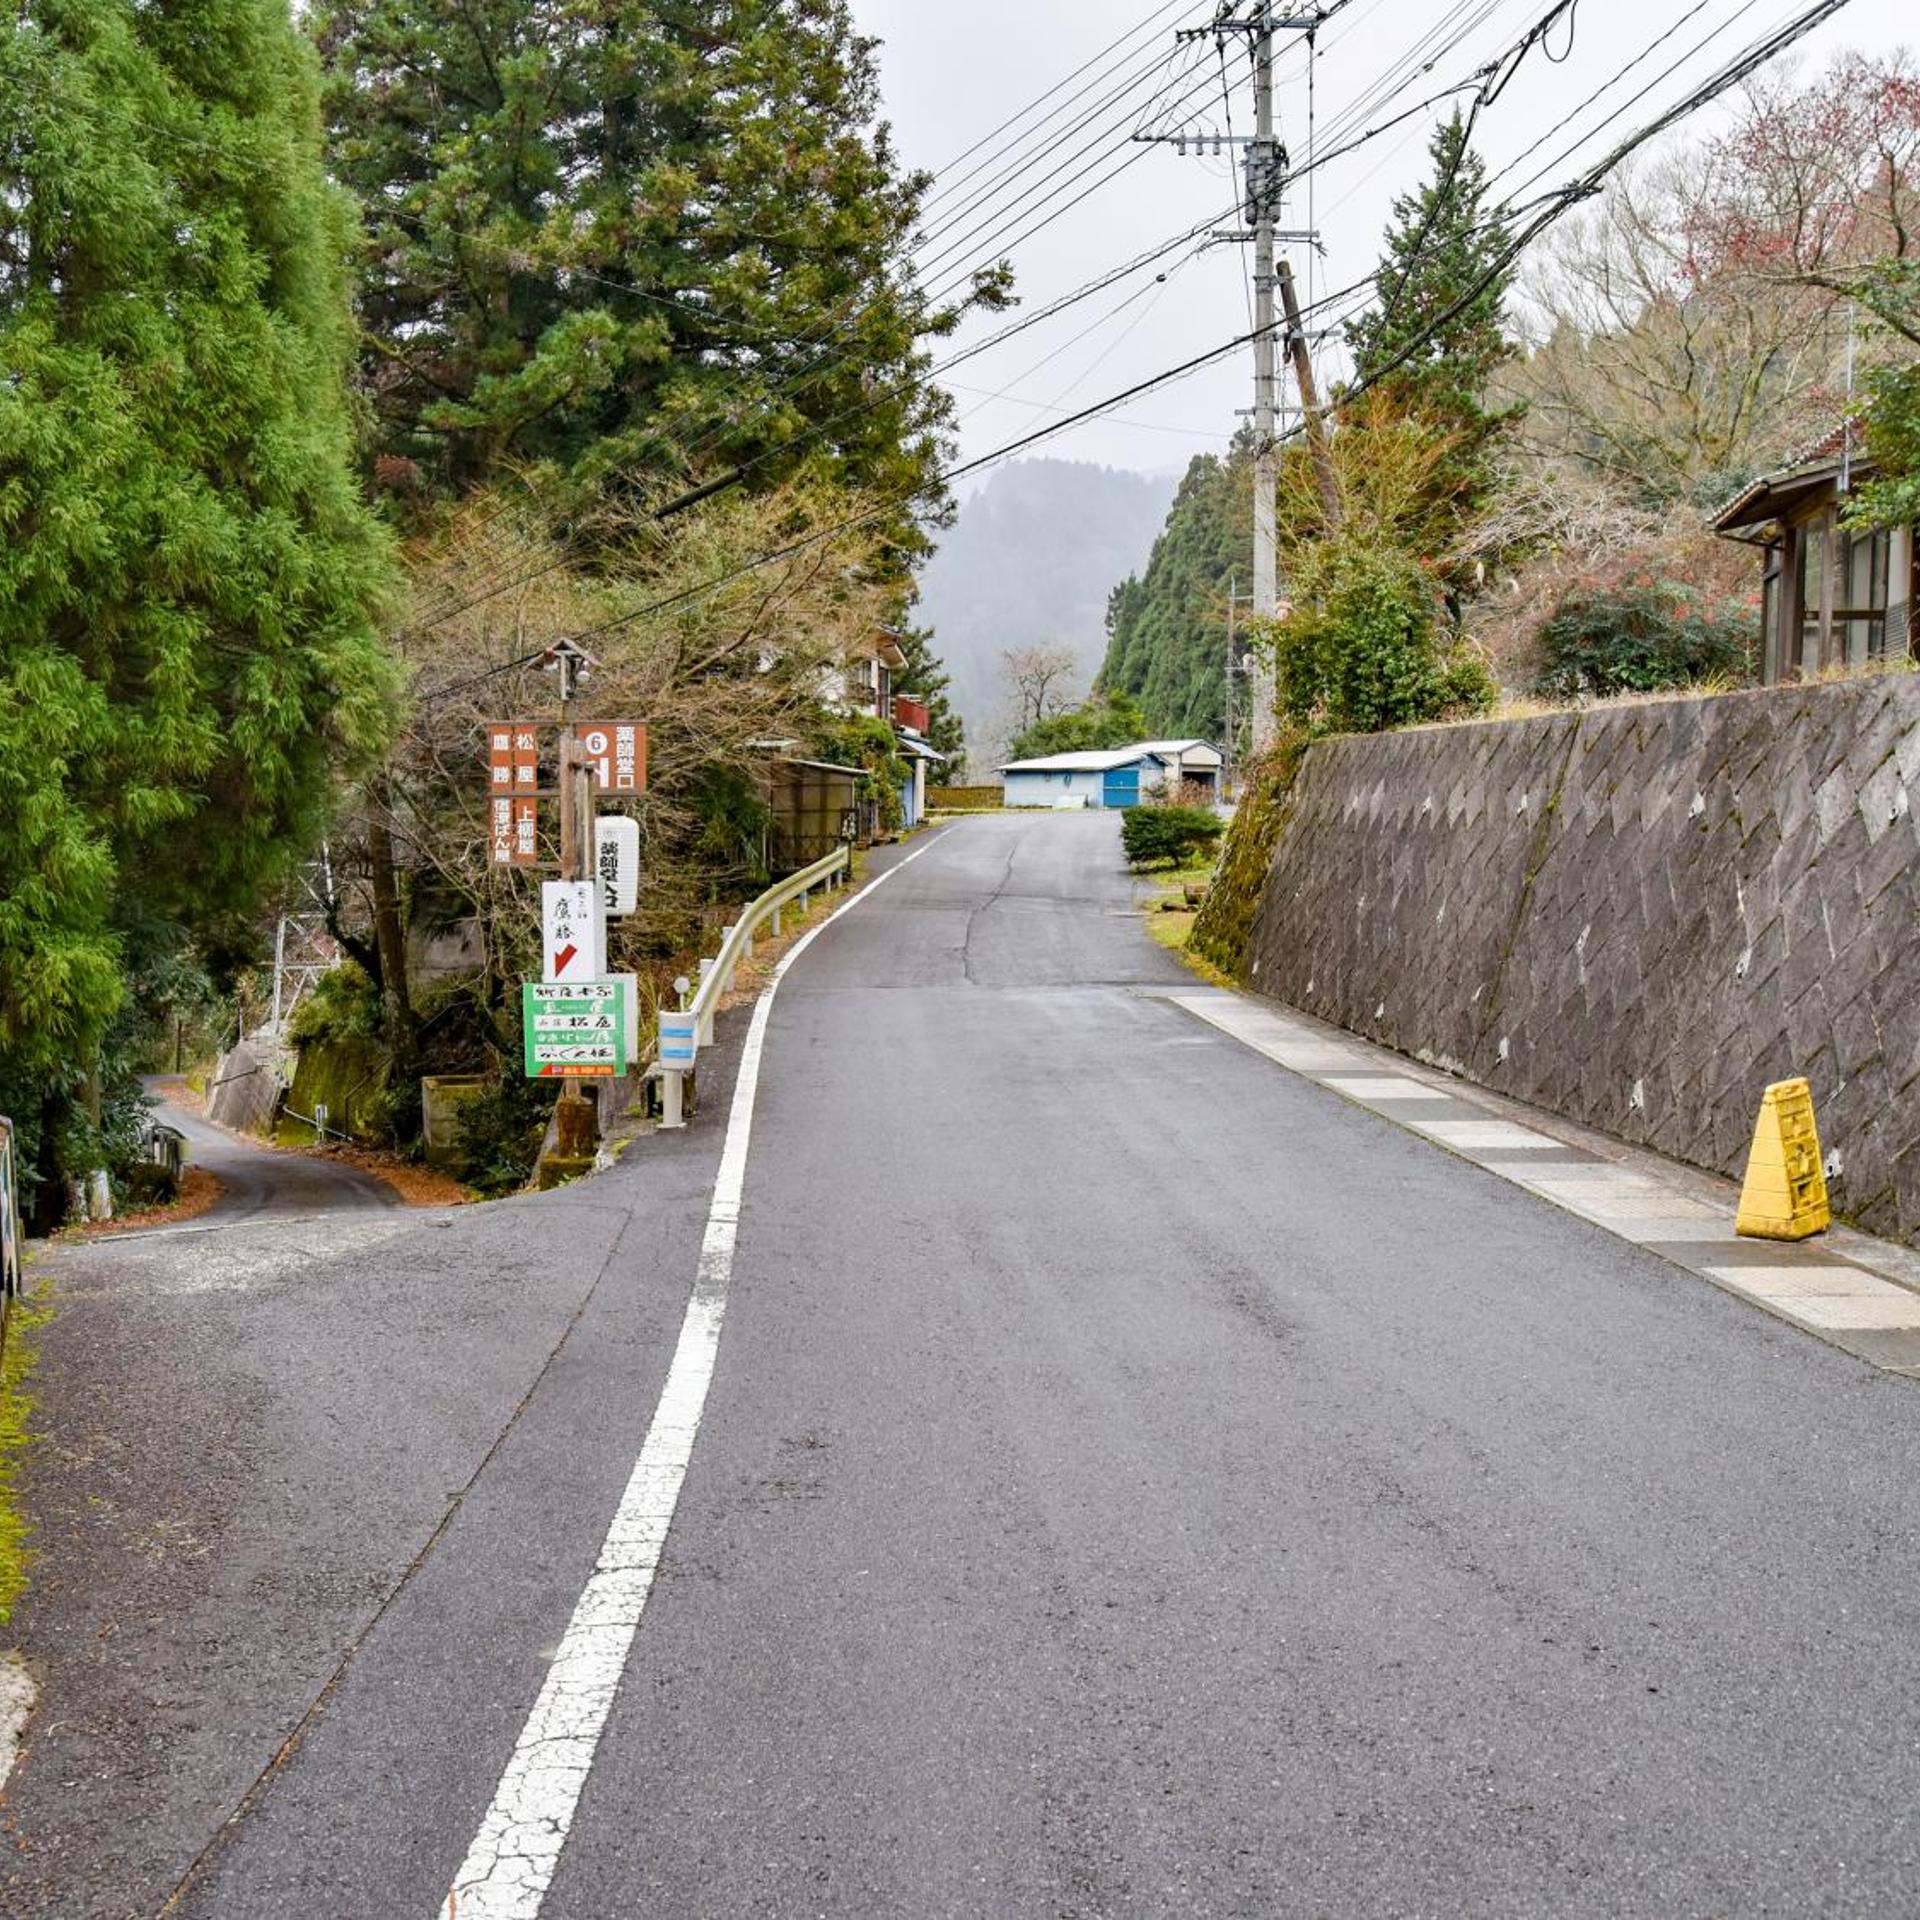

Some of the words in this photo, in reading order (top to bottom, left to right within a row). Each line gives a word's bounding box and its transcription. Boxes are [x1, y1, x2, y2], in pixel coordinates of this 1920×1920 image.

[516, 733, 534, 782] 松屋
[616, 726, 635, 789] 薬師堂口
